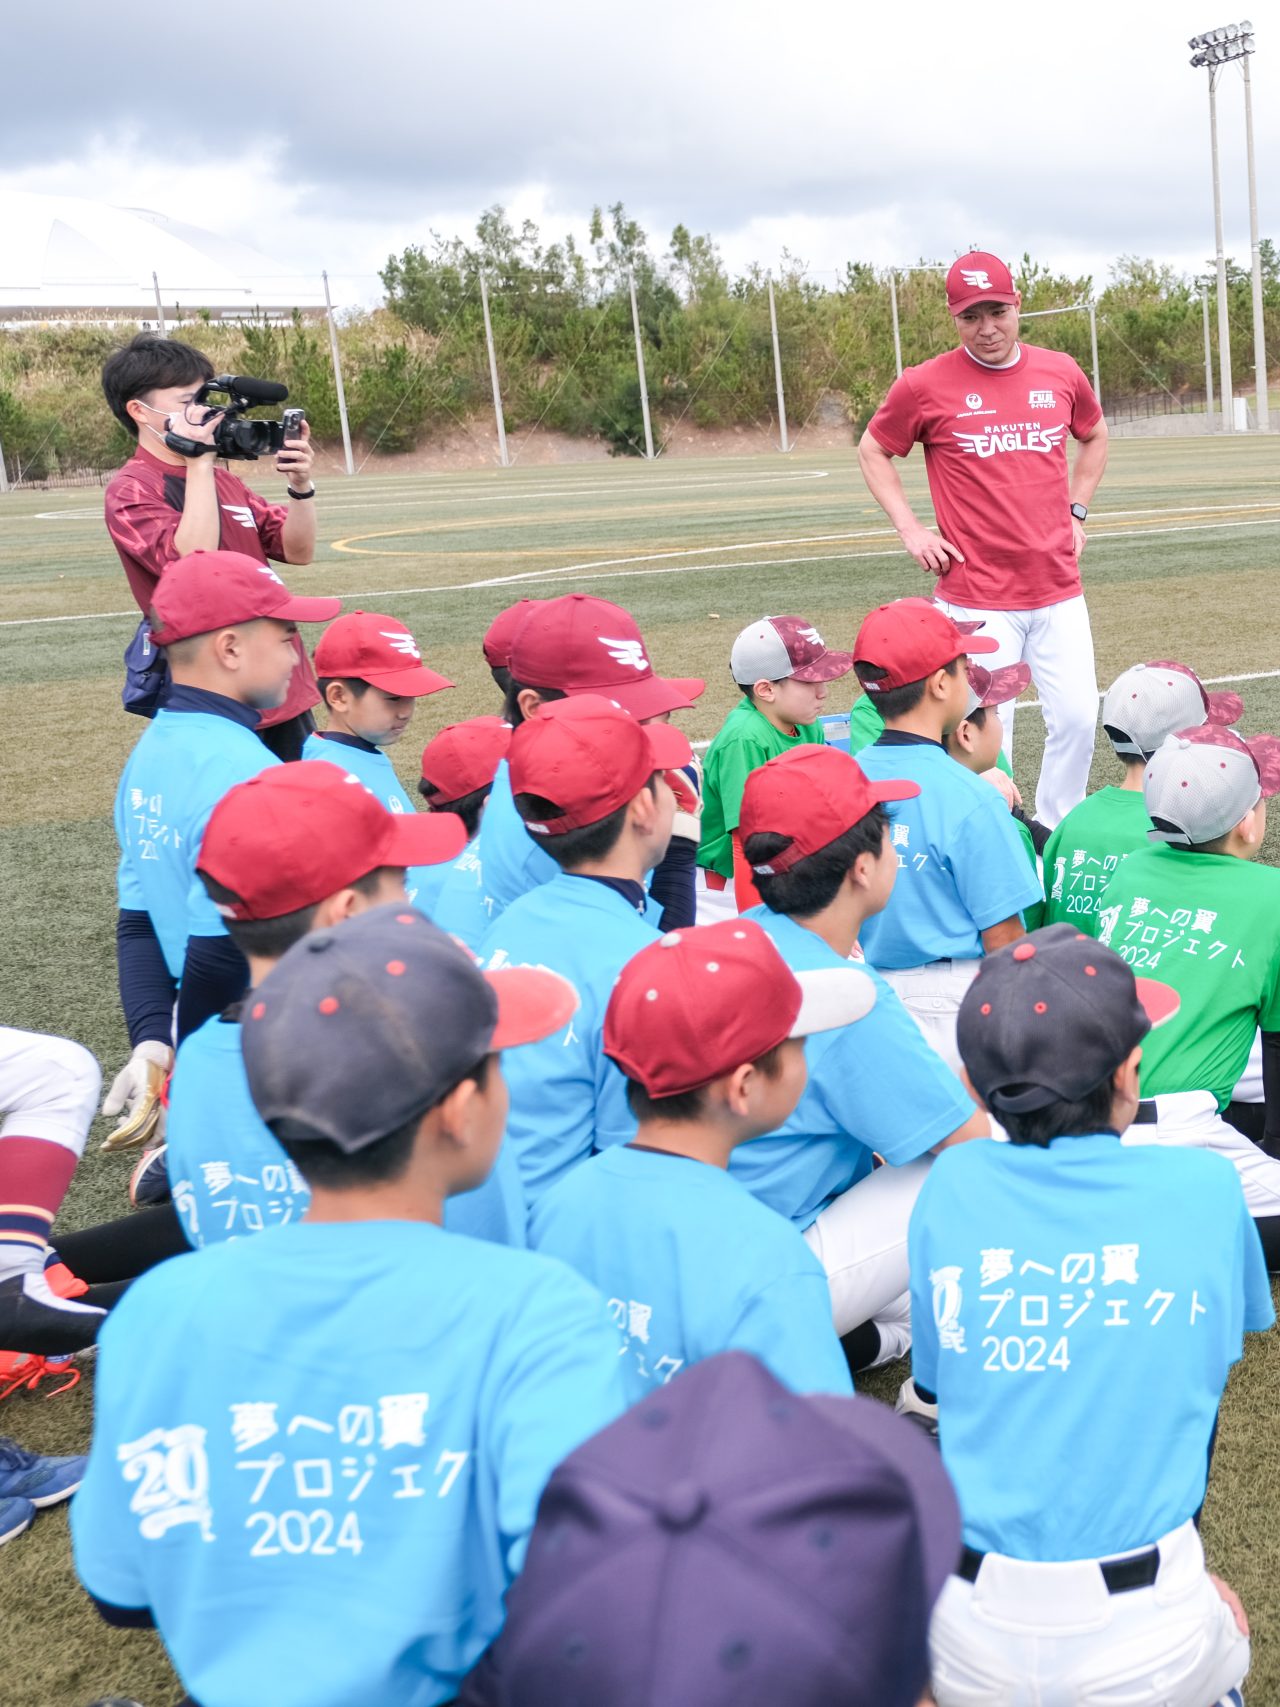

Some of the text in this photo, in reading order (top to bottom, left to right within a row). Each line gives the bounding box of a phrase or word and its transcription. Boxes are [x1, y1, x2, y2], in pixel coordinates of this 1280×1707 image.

[953, 425, 1063, 458] EAGLES
[984, 422, 1040, 434] RAKUTEN
[1071, 849, 1129, 871] 夢への
[1129, 897, 1218, 934] 夢への翼
[1124, 920, 1245, 969] プロジェクト
[979, 1243, 1140, 1288] 夢への翼
[978, 1288, 1207, 1329] プロジェクト
[981, 1336, 1071, 1372] 2024
[228, 1392, 429, 1453] 夢への翼
[245, 1508, 364, 1557] 2024
